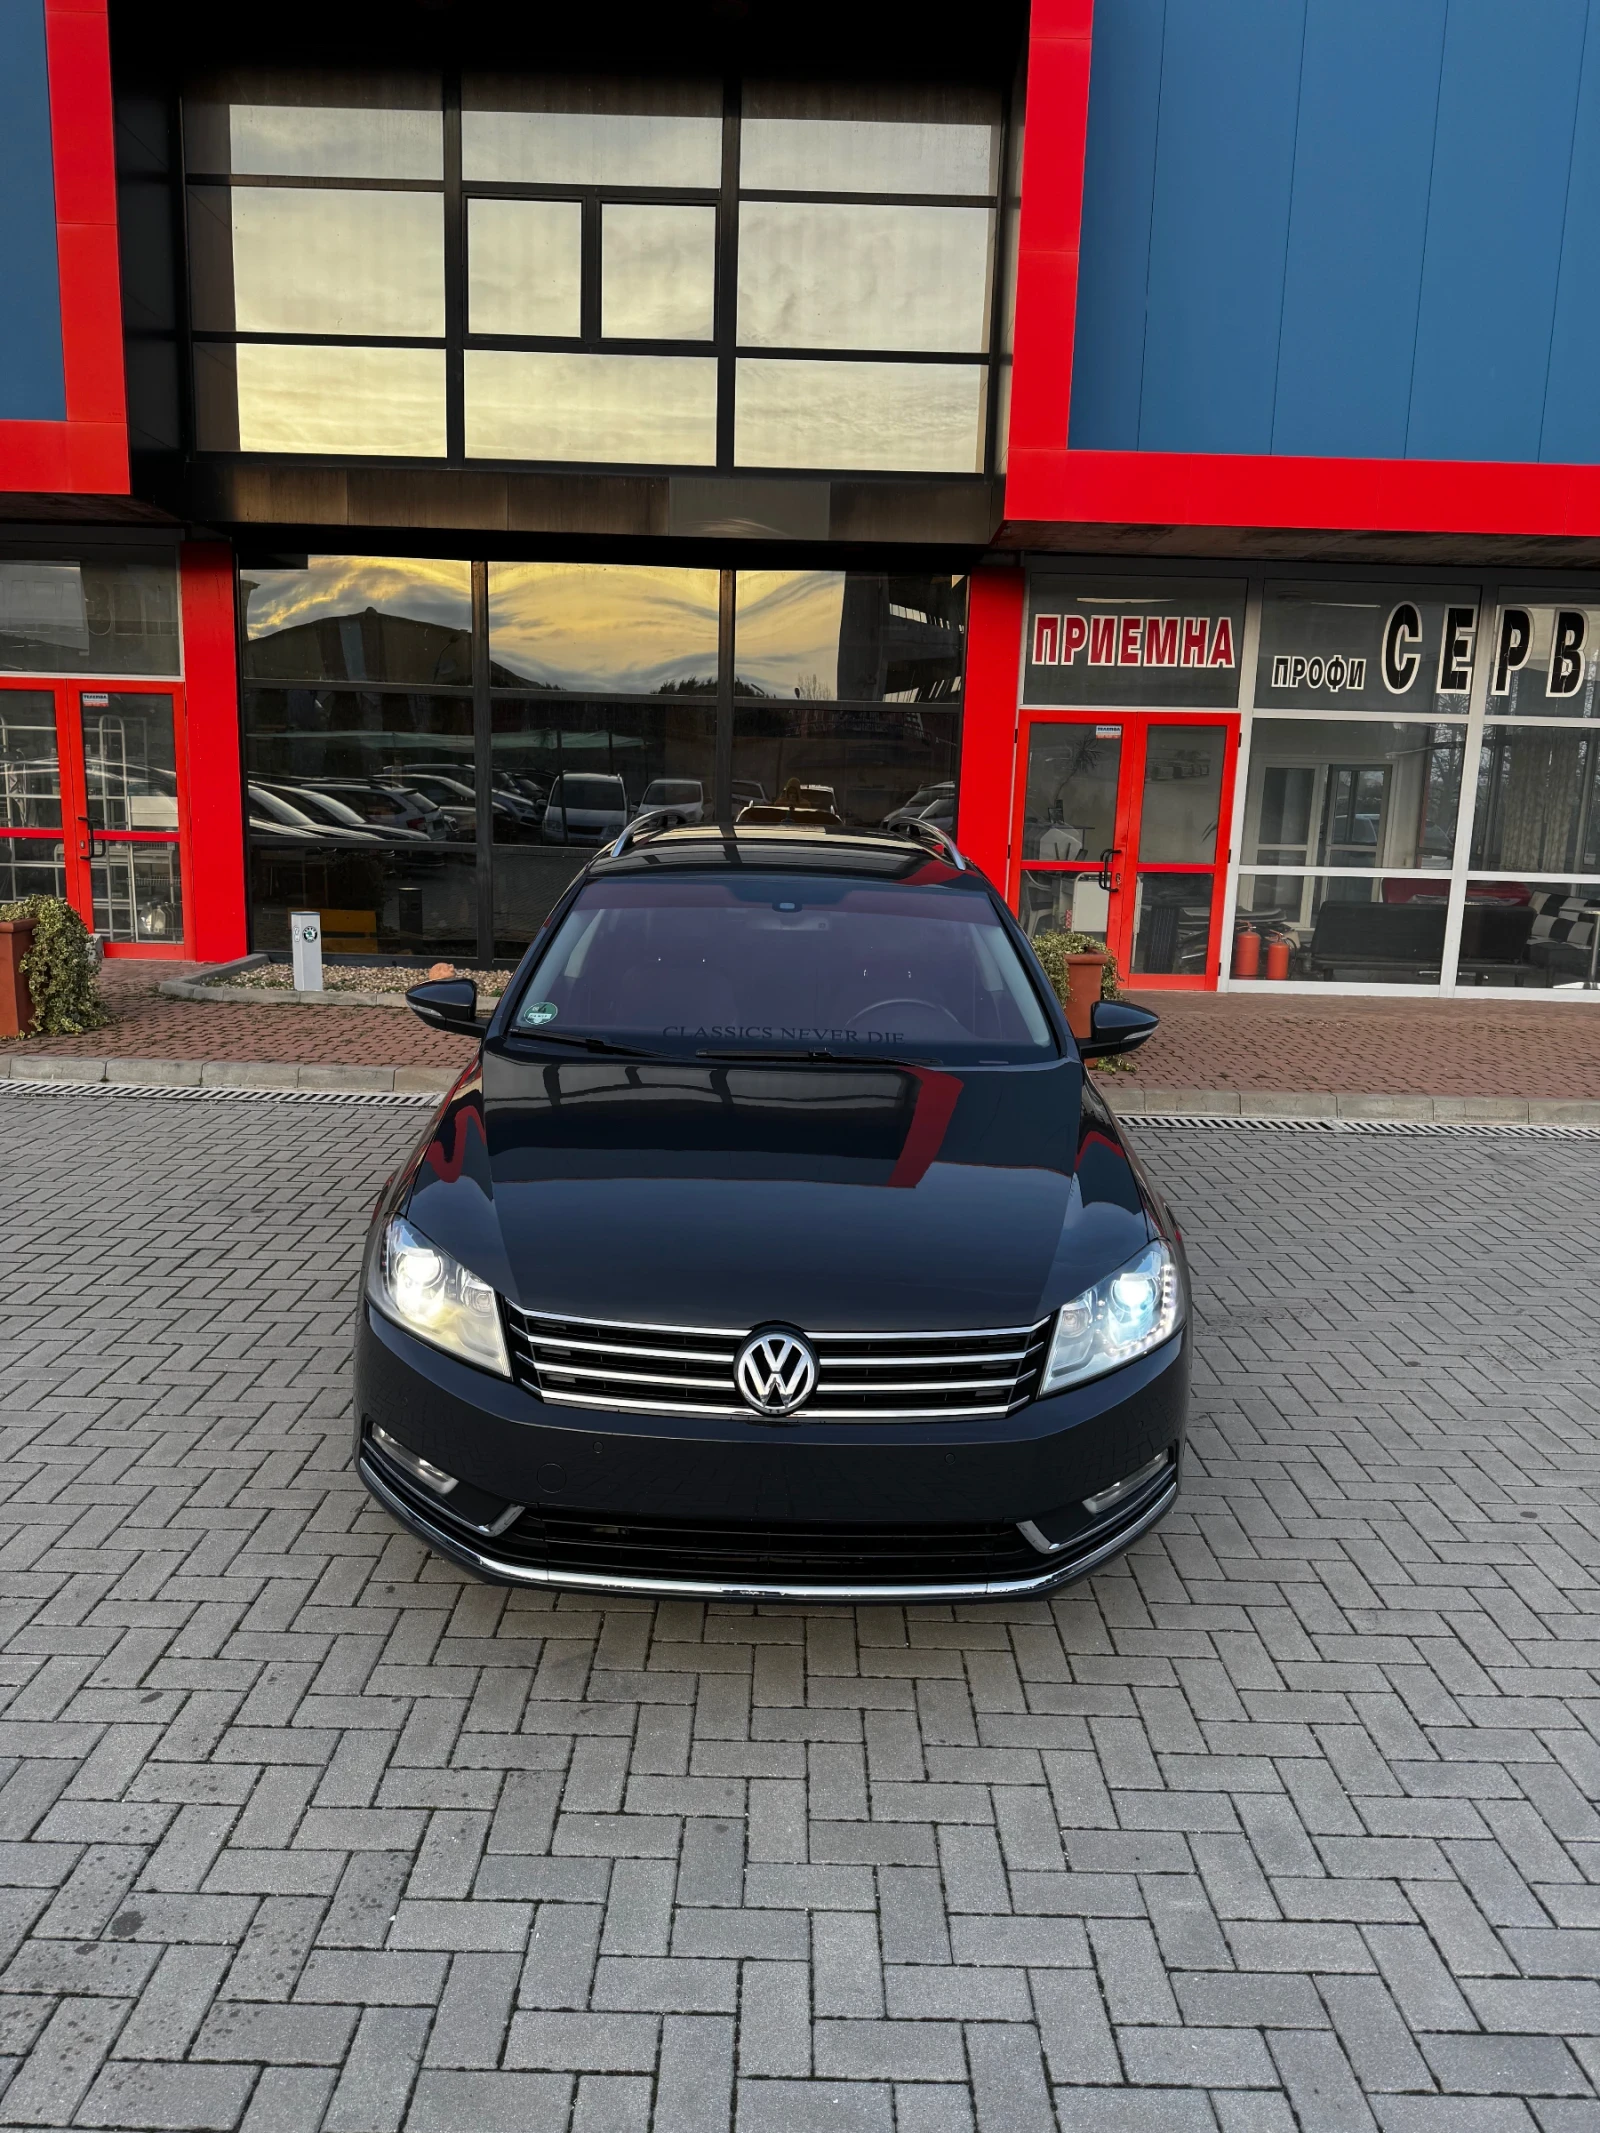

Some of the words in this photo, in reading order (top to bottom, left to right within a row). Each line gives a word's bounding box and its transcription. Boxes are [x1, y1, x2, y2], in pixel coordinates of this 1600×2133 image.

[1031, 613, 1236, 669] ПРИЕМНА
[1270, 653, 1367, 693] ПРОФИ
[1380, 600, 1590, 698] СЕРВ
[662, 1025, 773, 1039] CLASSICS
[779, 1026, 860, 1043] NEVER
[867, 1031, 906, 1045] DIE
